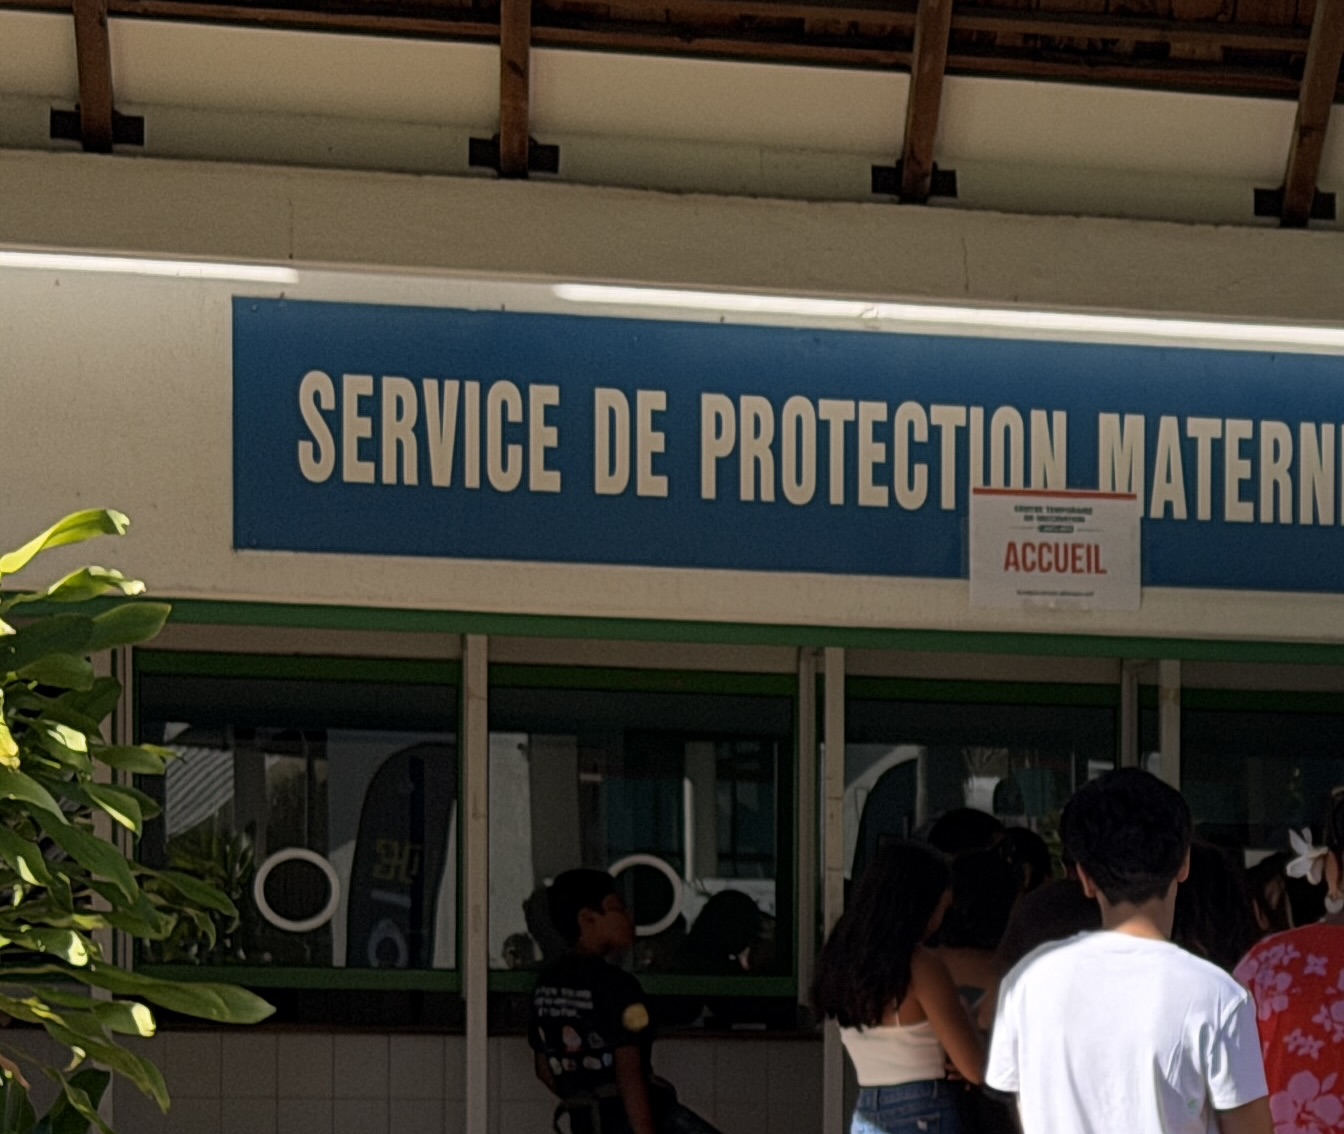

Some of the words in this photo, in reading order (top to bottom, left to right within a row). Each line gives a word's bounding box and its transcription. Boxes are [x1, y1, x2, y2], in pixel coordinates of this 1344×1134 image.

[299, 370, 561, 493] SERVICE
[594, 387, 668, 497] DE
[700, 393, 1067, 510] PROTECTION
[1004, 541, 1107, 574] ACCUEIL
